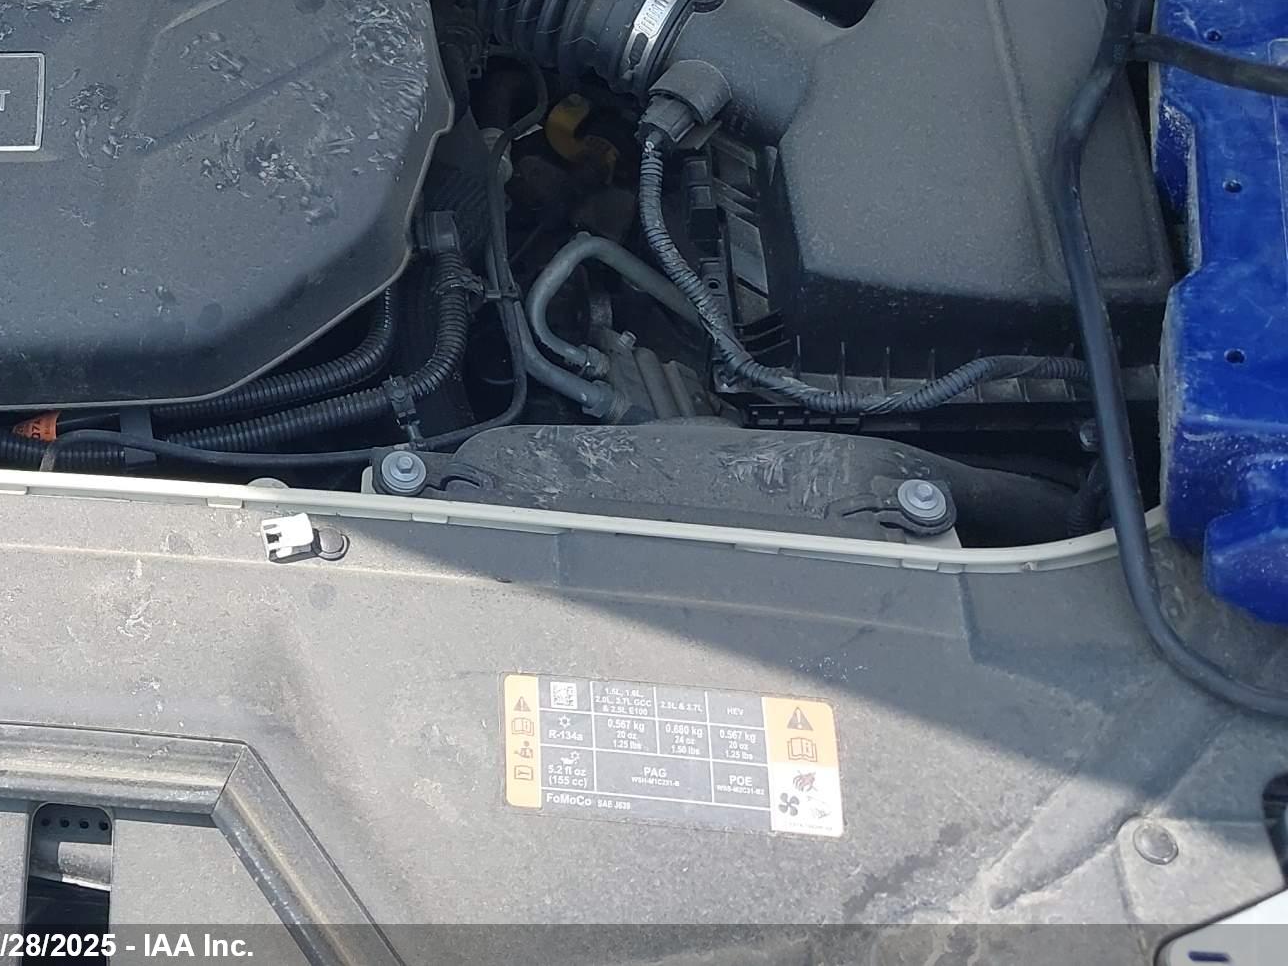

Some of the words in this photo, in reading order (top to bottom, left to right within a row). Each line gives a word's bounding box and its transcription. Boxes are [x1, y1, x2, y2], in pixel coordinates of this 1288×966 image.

[608, 719, 631, 730] 0.567
[633, 721, 645, 733] kg
[691, 726, 703, 738] kg
[548, 729, 583, 741] R-134a
[617, 731, 625, 739] 20
[720, 729, 742, 740] 0.567
[744, 732, 756, 743] kg
[613, 740, 628, 748] 1.25
[729, 741, 738, 749] 20
[739, 742, 749, 750] oz
[548, 765, 563, 775] 5.2
[565, 765, 572, 775] fl
[574, 767, 586, 776] oz
[643, 766, 667, 778] PAG
[548, 776, 570, 786] (155
[572, 778, 587, 788] cc)
[729, 775, 753, 786] POE
[546, 793, 592, 806] FoMoCo
